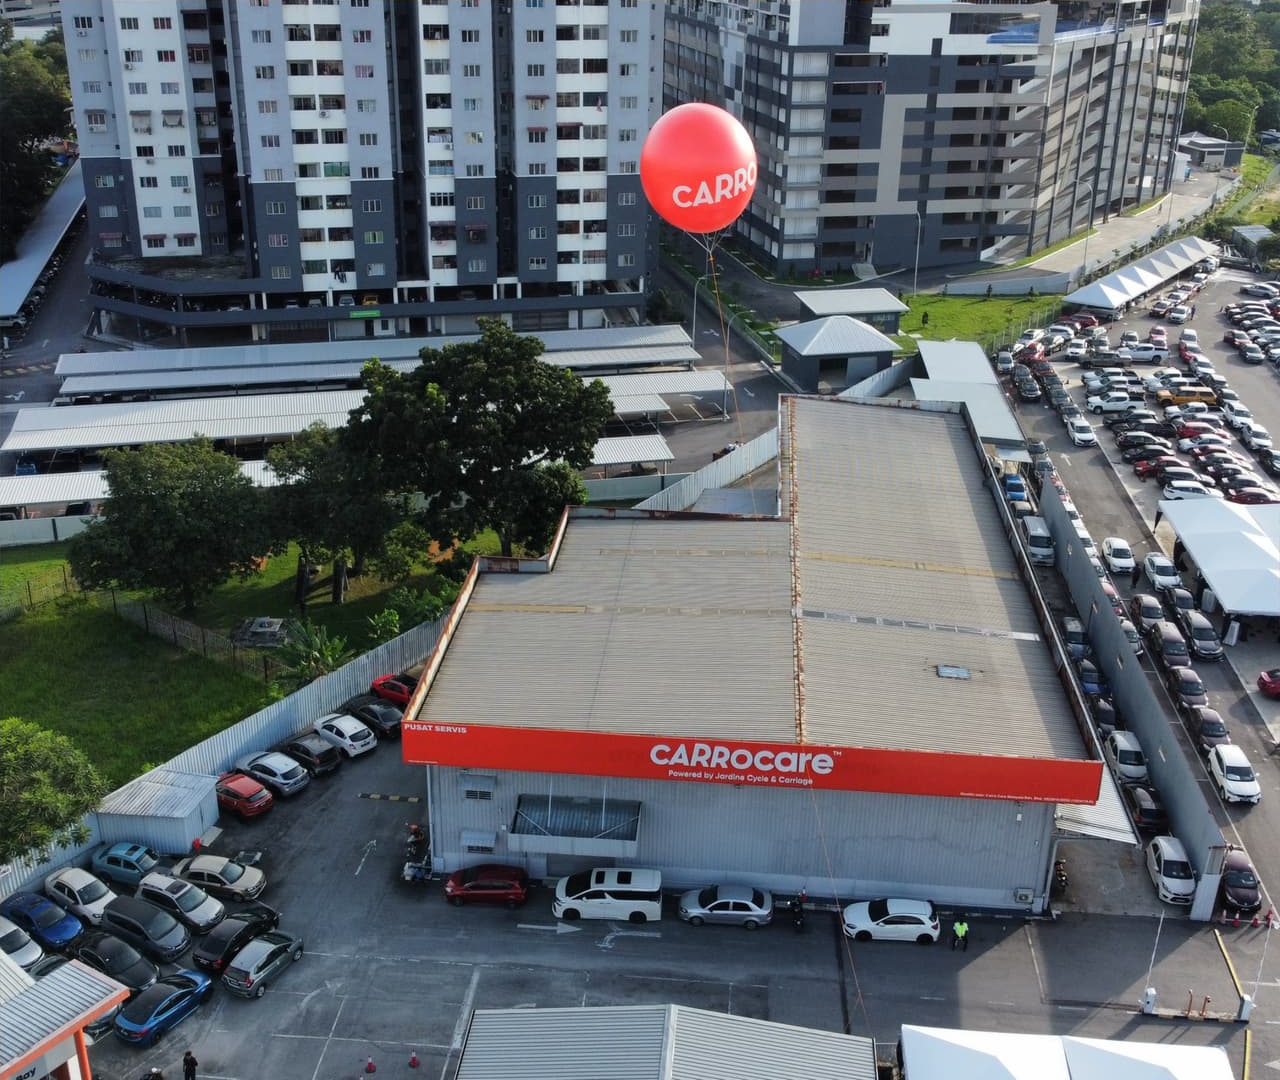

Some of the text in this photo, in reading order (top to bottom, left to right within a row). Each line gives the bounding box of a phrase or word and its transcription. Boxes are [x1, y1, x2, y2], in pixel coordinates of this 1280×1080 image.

[673, 161, 757, 208] CARRO
[404, 723, 467, 734] PUSAT SERVIS
[668, 770, 702, 778] Powered
[703, 771, 714, 780] by
[714, 772, 745, 781] Jardine
[746, 774, 769, 783] Cycle
[778, 776, 813, 786] Carriage
